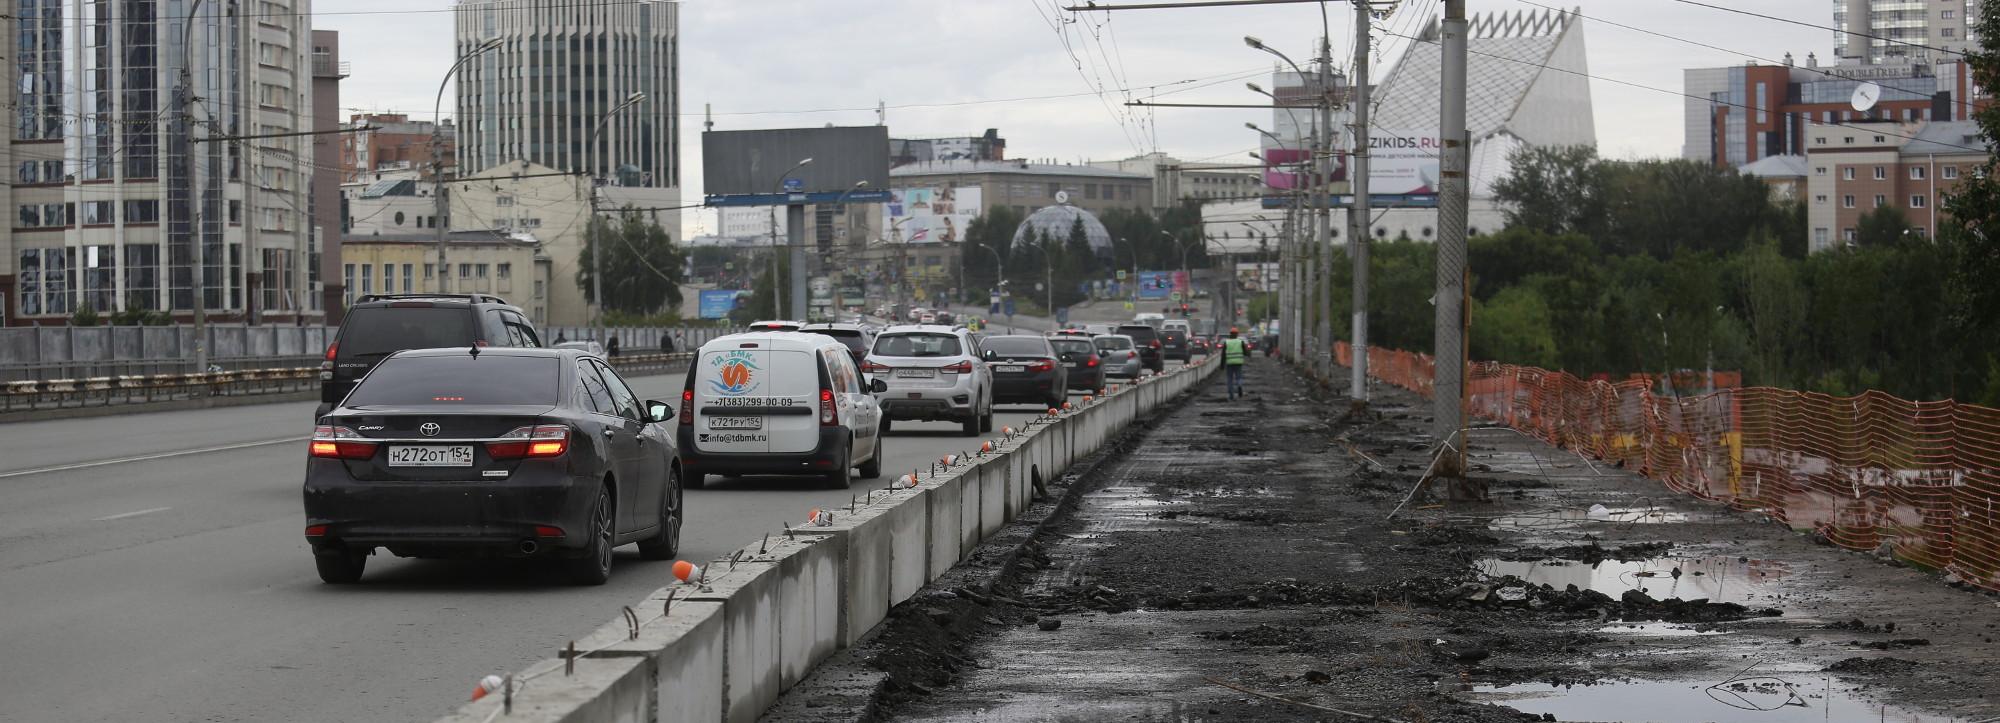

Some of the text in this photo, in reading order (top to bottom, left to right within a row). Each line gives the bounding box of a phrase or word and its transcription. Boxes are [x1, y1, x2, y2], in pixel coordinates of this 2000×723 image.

[1368, 137, 1440, 148] ZIKIDS.RU
[714, 397, 793, 407] +7(383)299-00-09
[709, 433, 767, 443] info@tdbmk.ru
[449, 447, 470, 459] 154
